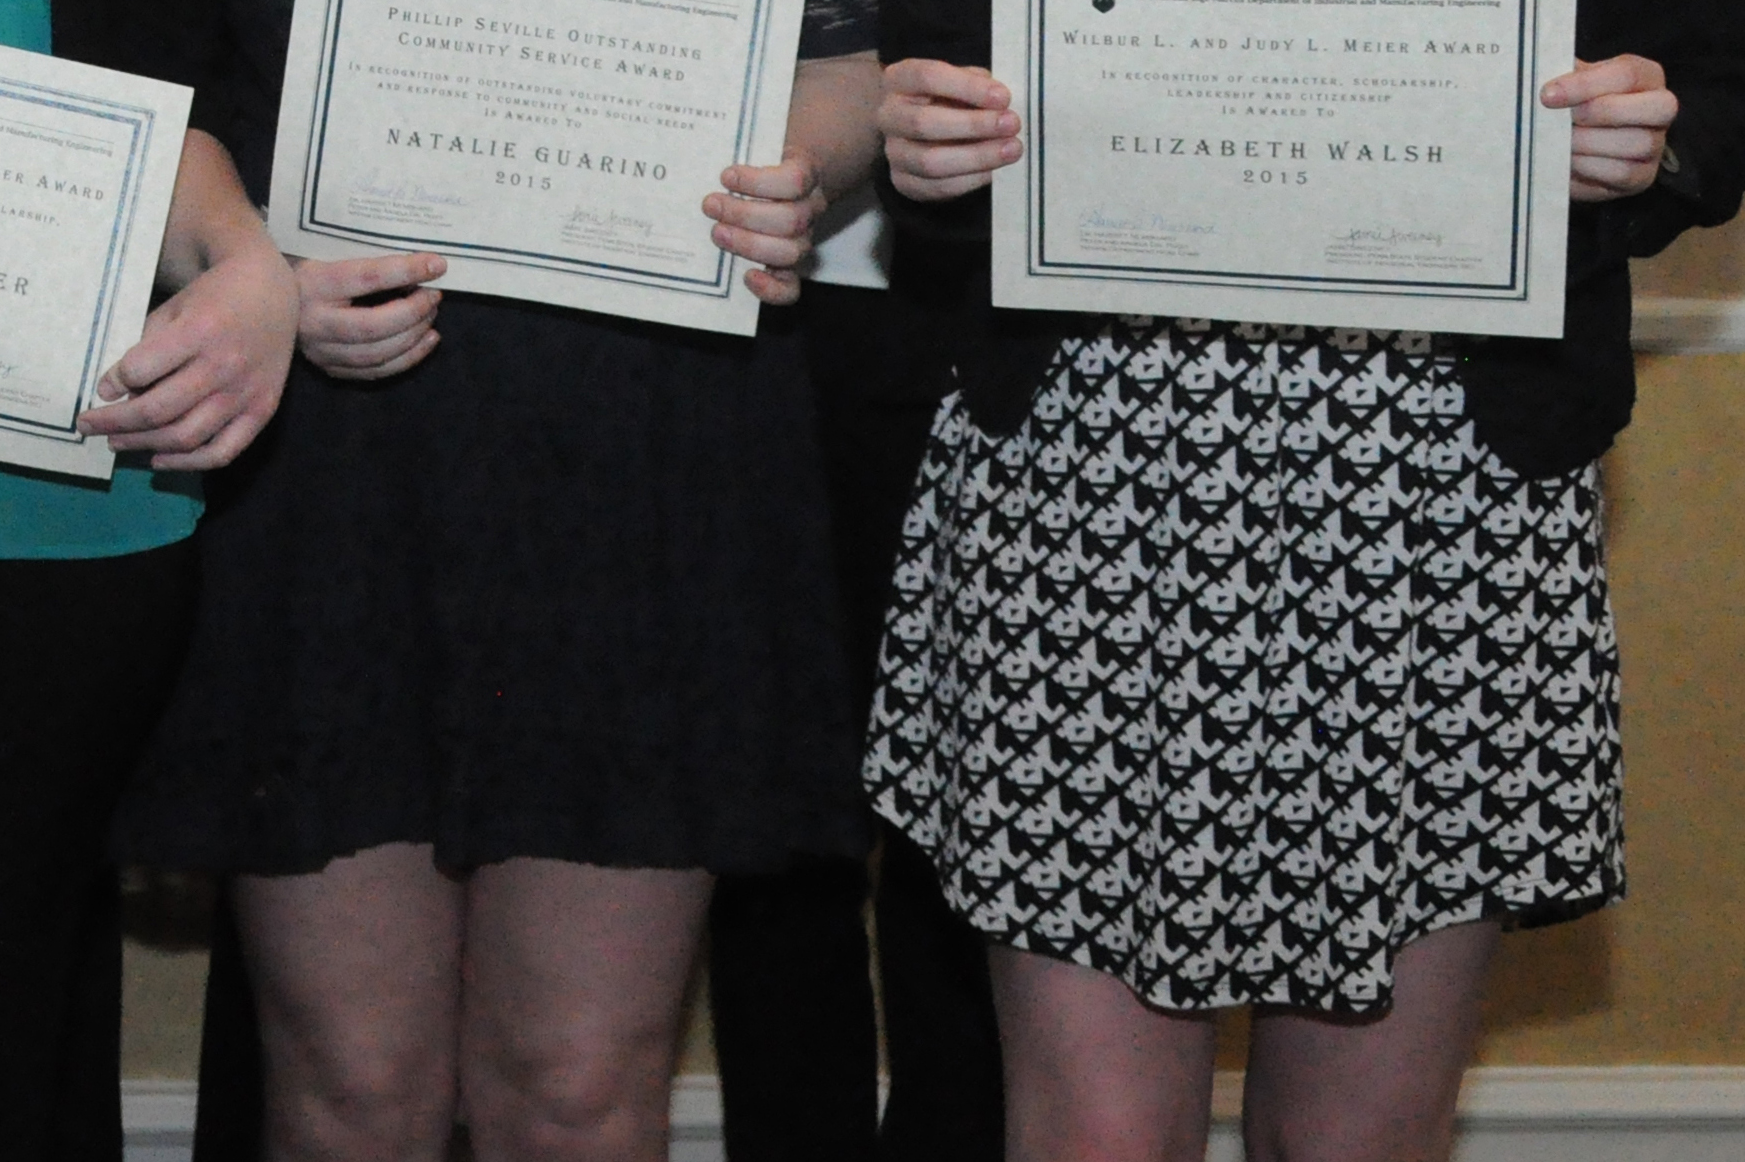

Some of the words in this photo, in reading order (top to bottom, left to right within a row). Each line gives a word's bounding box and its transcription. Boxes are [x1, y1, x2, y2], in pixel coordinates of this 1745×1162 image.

[635, 0, 691, 13] Manufacturing
[692, 7, 738, 20] Engineering
[1447, 0, 1501, 8] Engineering
[388, 7, 464, 28] PHILLIP
[475, 17, 555, 40] SEVILLE
[568, 29, 702, 60] OUTSTANDING
[1063, 30, 1140, 47] WILBUR
[1154, 34, 1174, 48] L.
[1190, 38, 1228, 49] AND
[1241, 37, 1295, 51] JUDY
[1307, 38, 1328, 52] L.
[1344, 39, 1409, 54] MEIER
[1424, 40, 1500, 55] AWARD
[398, 32, 510, 57] COMMUNITY
[520, 46, 602, 70] SERVICE
[615, 60, 685, 81] AWARD
[348, 61, 361, 71] IN
[369, 65, 449, 81] RECOGNITION
[456, 76, 470, 84] OF
[478, 78, 562, 96] OUTSTANDING
[570, 89, 642, 107] VOLUNTARY
[648, 101, 727, 120] COMMITMENT
[1102, 70, 1116, 79] IN
[1125, 72, 1219, 82] RECOGNITION
[1227, 75, 1244, 83] OF
[1252, 75, 1344, 87] CHARACTER,
[1353, 78, 1458, 89] SCHOLARSHIP,
[378, 82, 400, 91] AND
[407, 85, 468, 99] RESPONSE
[476, 93, 490, 101] TO
[497, 95, 568, 112] COMMUNITY
[575, 105, 598, 116] AND
[605, 110, 649, 124] SOCIAL
[656, 118, 695, 130] NEEDS
[1167, 89, 1255, 99] LEADERSHIP
[1265, 92, 1292, 100] AND
[1300, 93, 1391, 102] CITIZENSHIP
[387, 128, 517, 158] NATALIE
[535, 146, 667, 180] GUARINO
[1111, 135, 1307, 159] ELIZABETH
[1328, 141, 1443, 163] WALSH
[37, 175, 105, 201] AWARD
[495, 171, 551, 190] 2015
[1243, 169, 1307, 185] 2015
